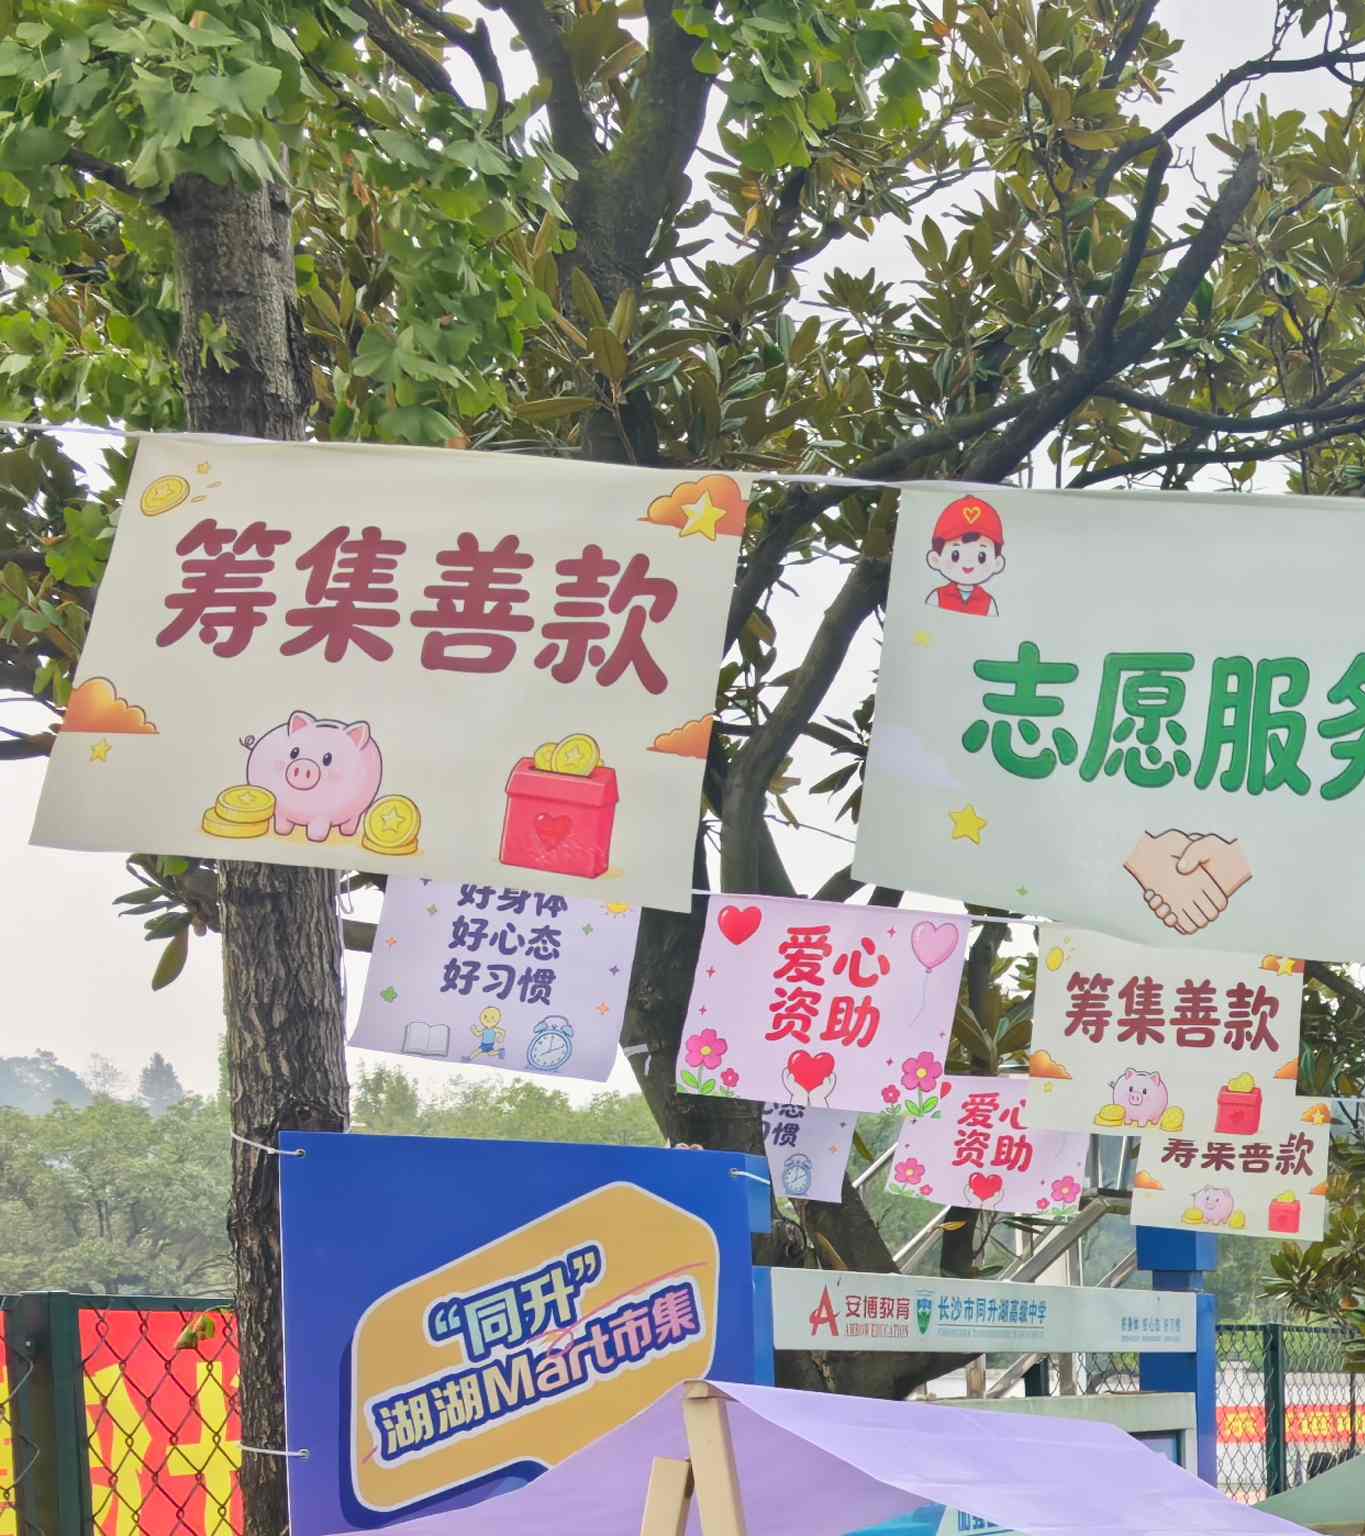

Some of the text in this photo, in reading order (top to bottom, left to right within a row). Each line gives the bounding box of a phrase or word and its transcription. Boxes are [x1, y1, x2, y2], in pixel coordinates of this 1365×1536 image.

[157, 518, 678, 695] 筹集善款
[448, 914, 562, 962] 好心态
[777, 925, 891, 988] 爱心
[439, 958, 557, 1007] 好习惯
[764, 987, 881, 1049] 资助
[1065, 971, 1280, 1054] 筹集善款
[958, 1092, 1029, 1131] 爱心
[952, 1128, 1035, 1173] 资助
[429, 1246, 602, 1356] “同升”
[845, 1294, 912, 1321] 安博教育
[937, 1296, 1048, 1326] 长沙市同升湖高级中学
[379, 1290, 699, 1458] 湖湖Mart市集
